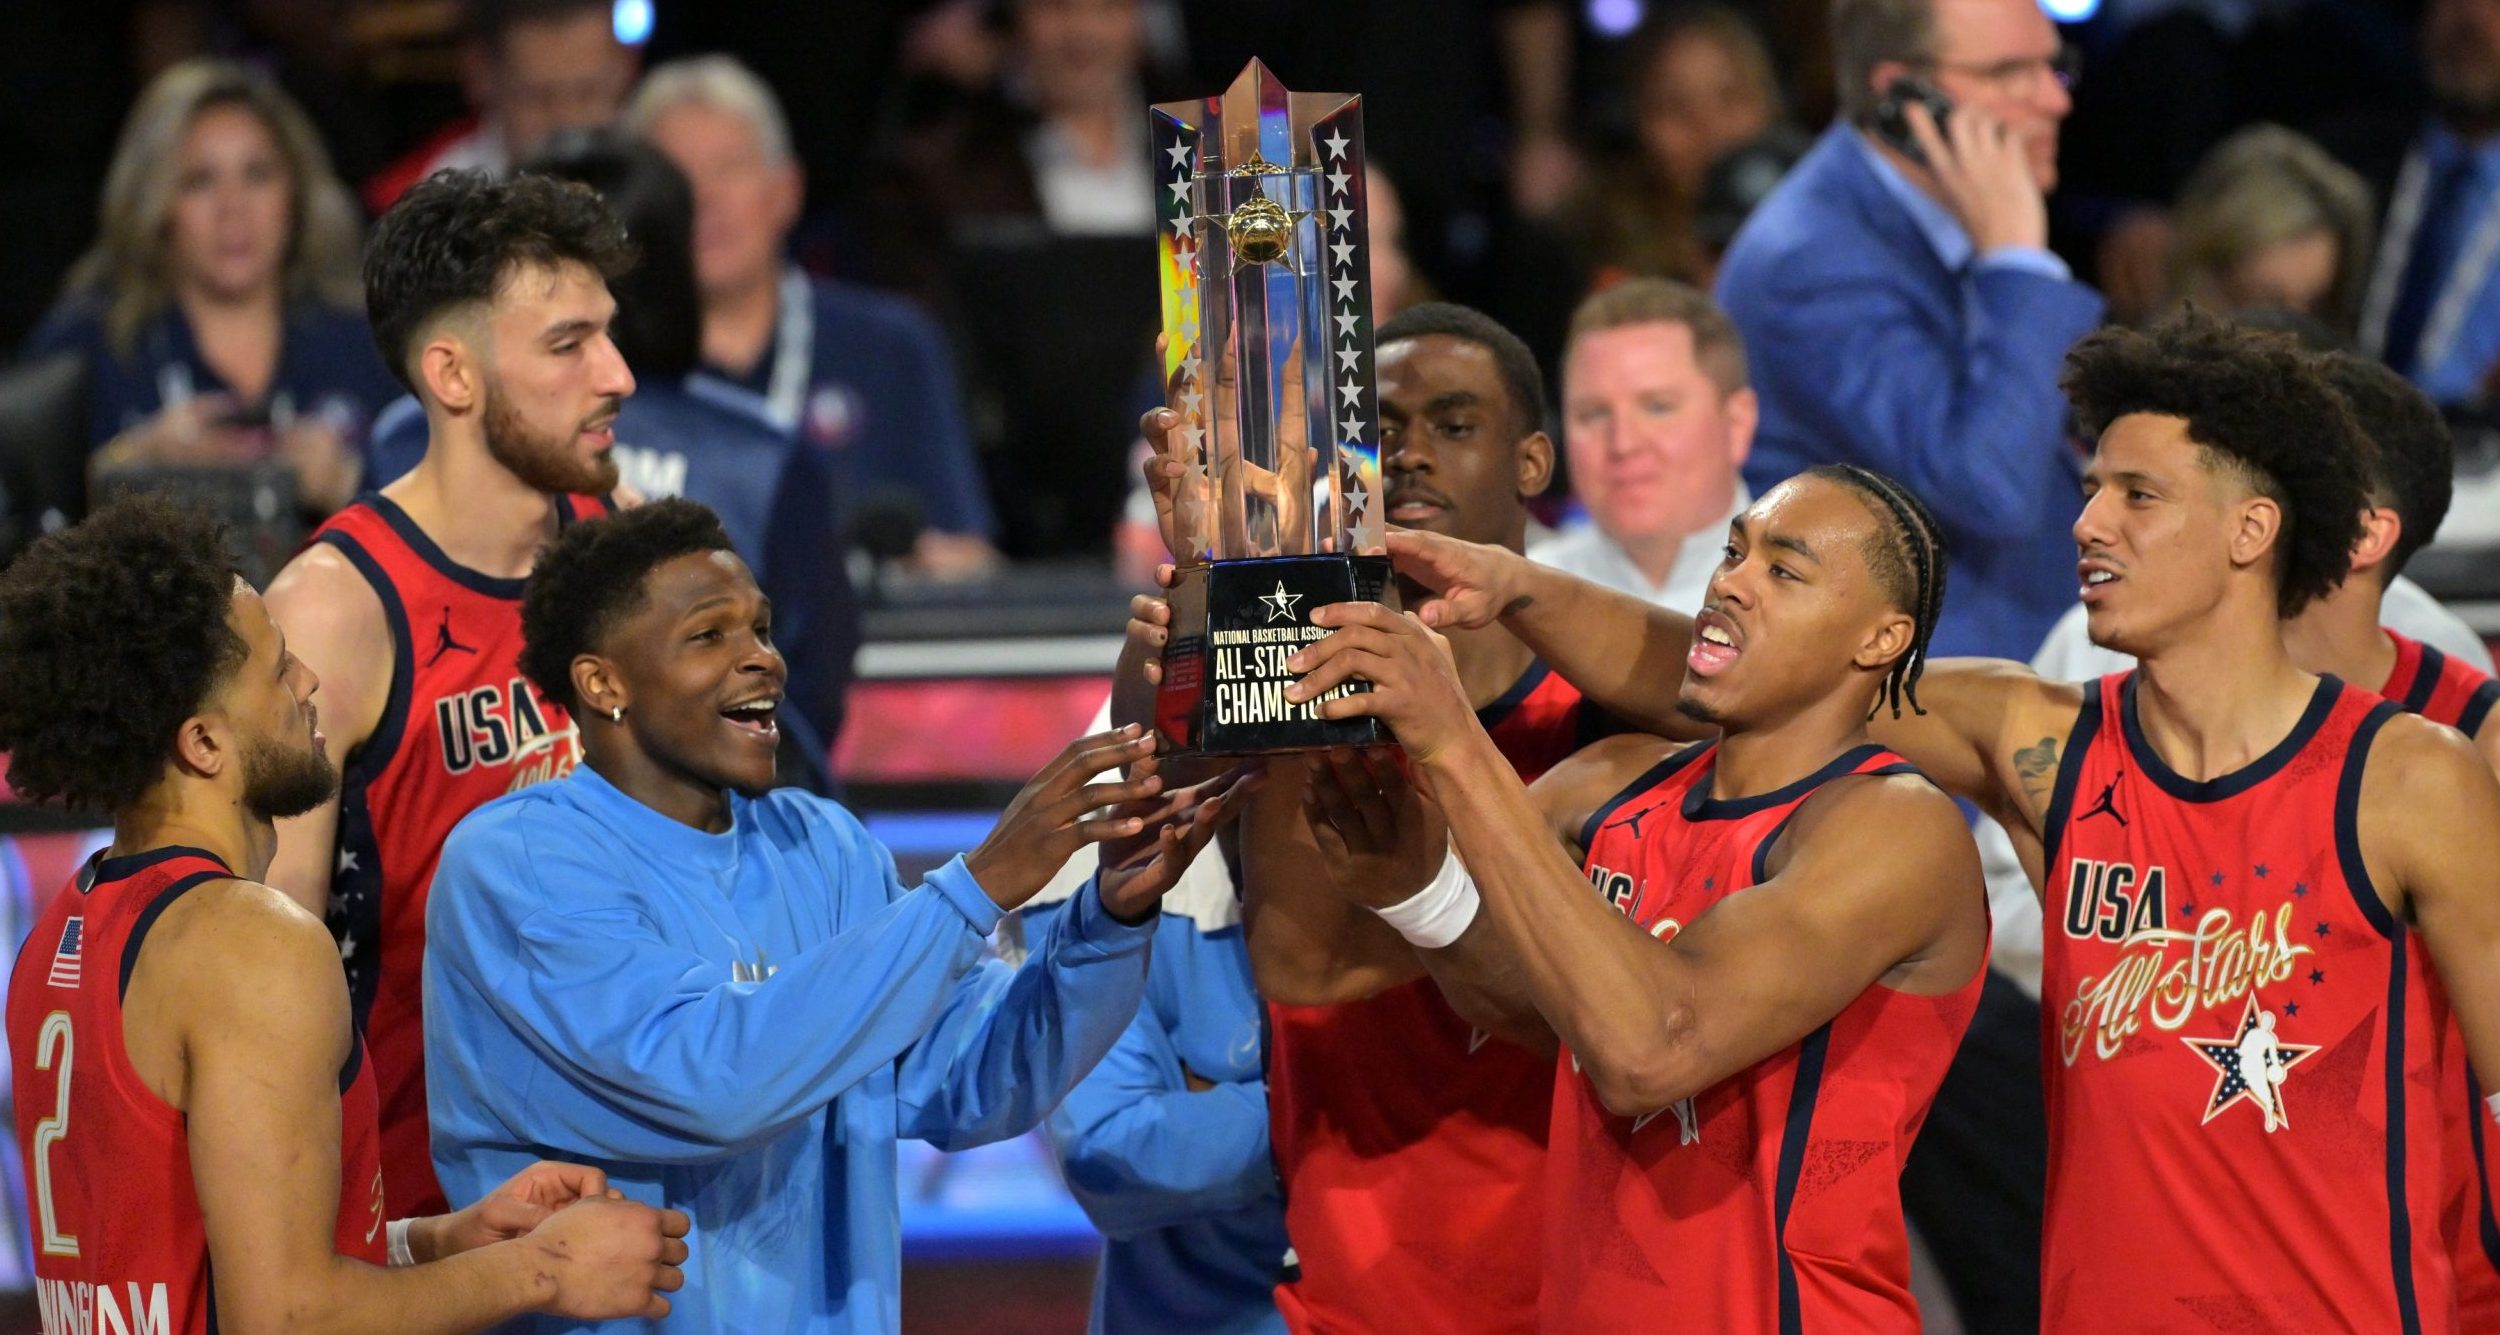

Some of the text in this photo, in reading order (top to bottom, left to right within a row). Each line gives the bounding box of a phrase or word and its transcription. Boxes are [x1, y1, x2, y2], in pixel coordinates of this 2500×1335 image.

[1213, 630, 1251, 645] NATIONAL
[1252, 627, 1300, 644] BASKETBALL
[435, 676, 552, 776] USA
[2064, 857, 2169, 948] USA
[2062, 901, 2315, 1068] All Stars
[34, 1009, 81, 1258] 2
